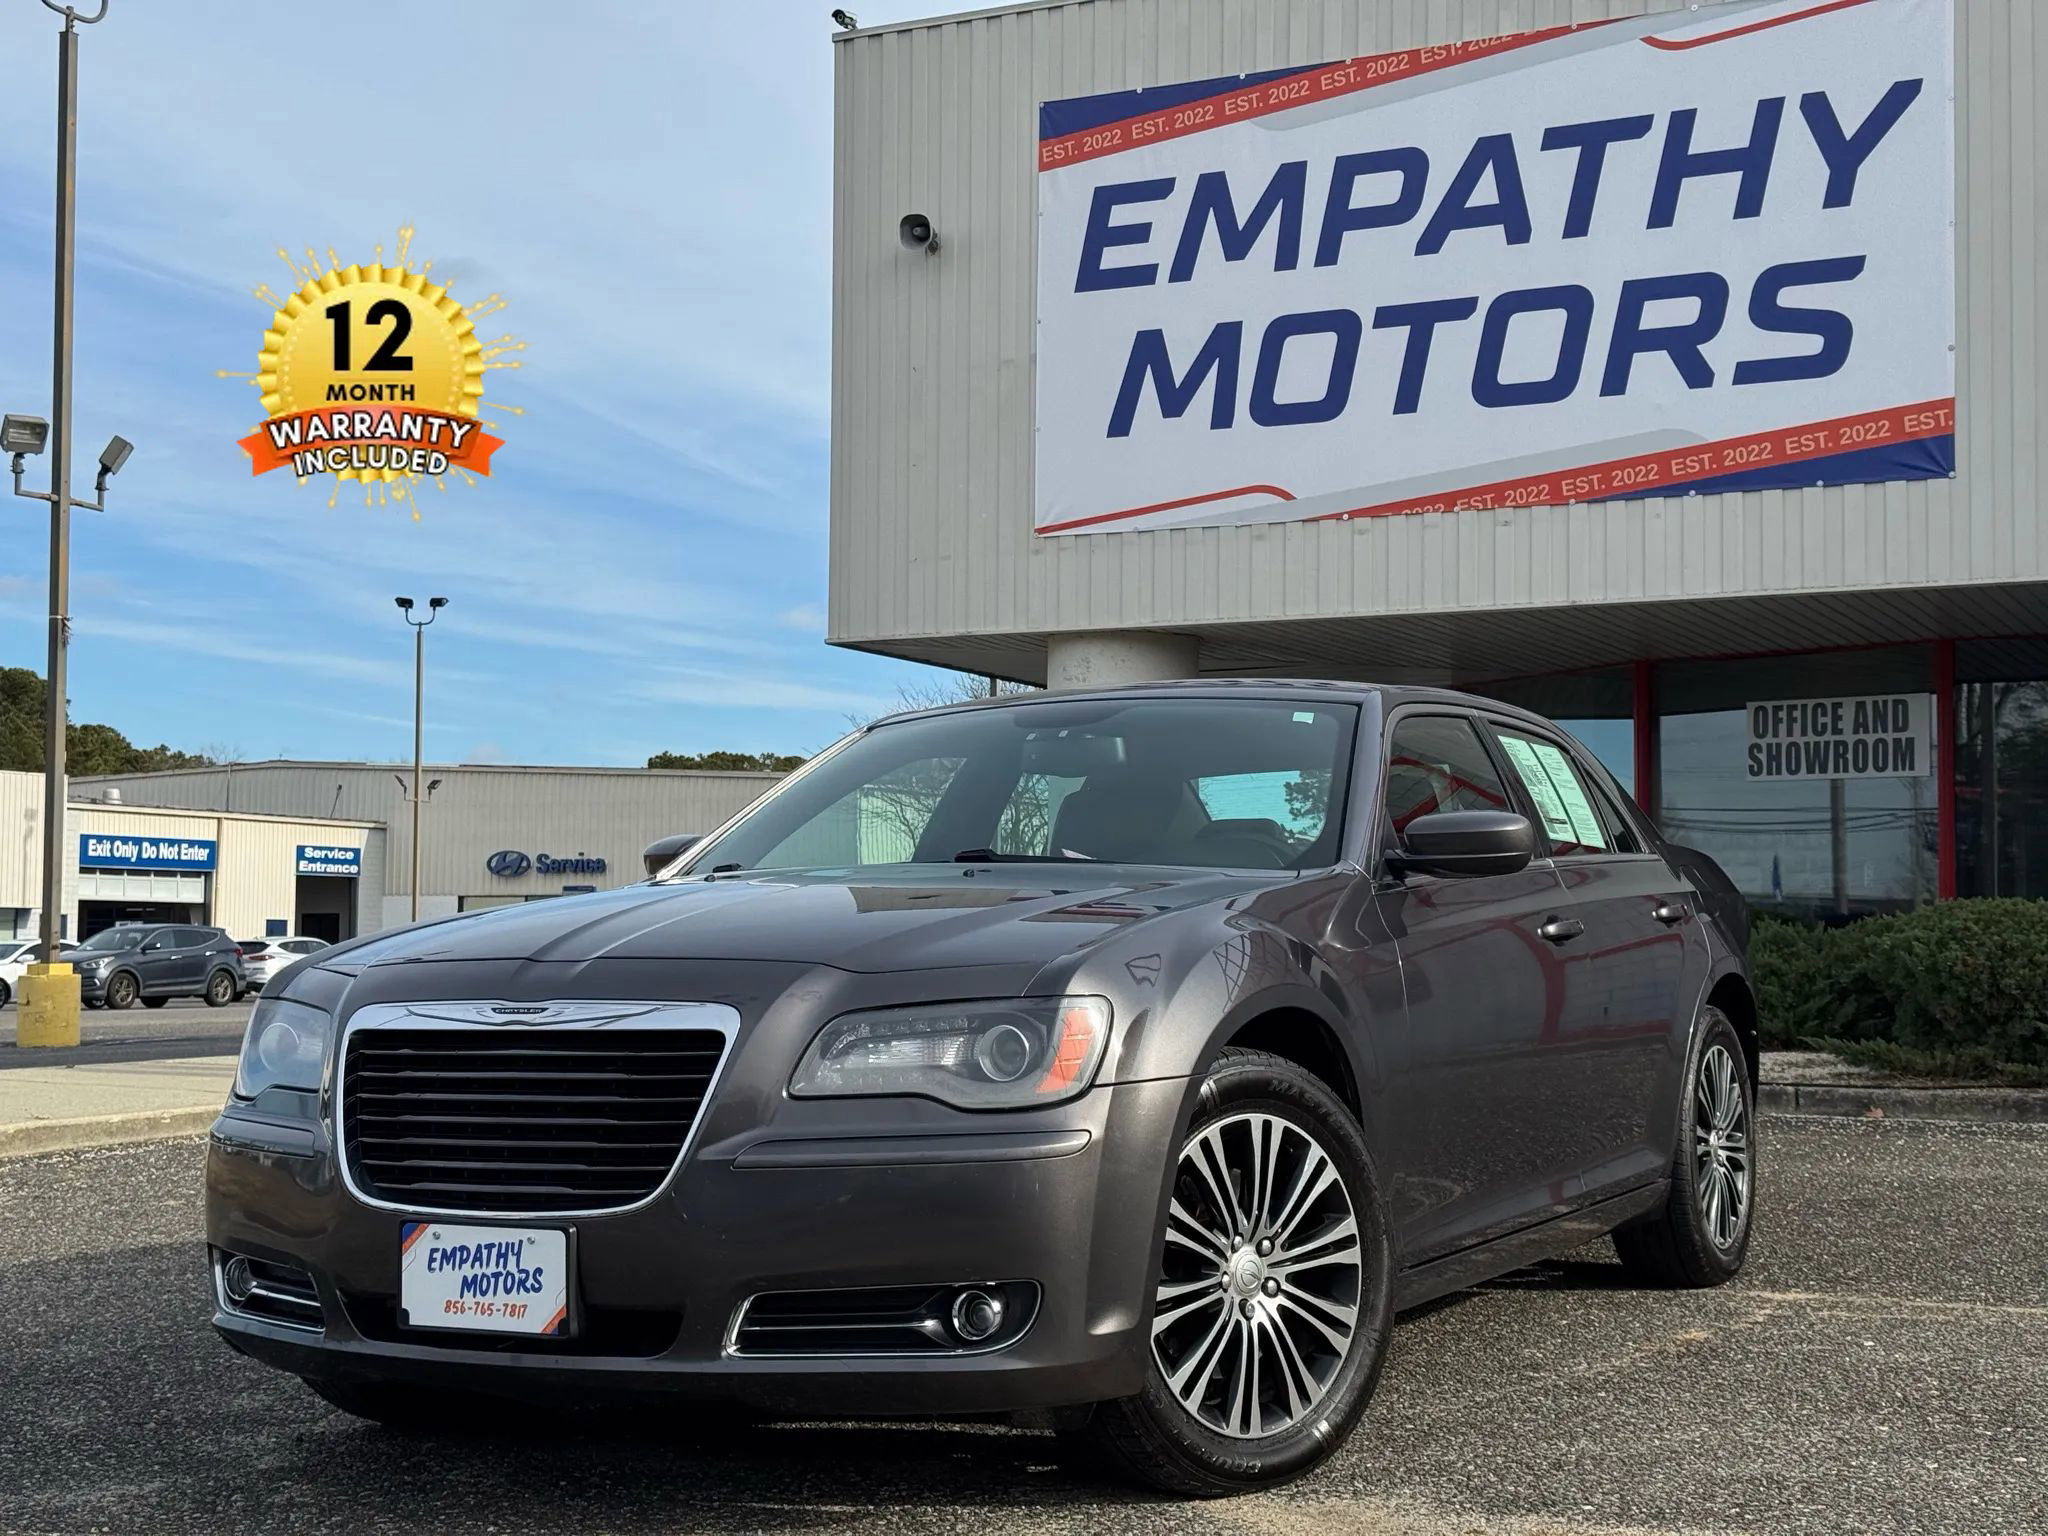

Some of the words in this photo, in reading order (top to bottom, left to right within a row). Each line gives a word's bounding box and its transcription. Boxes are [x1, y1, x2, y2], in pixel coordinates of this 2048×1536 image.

[1042, 141, 1078, 163] EST.
[1083, 129, 1122, 152] 2022
[1131, 117, 1169, 140] EST.
[1174, 105, 1215, 129] 2022
[1224, 93, 1263, 115] EST.
[1268, 80, 1310, 105] 2022
[1320, 67, 1361, 91] EST.
[1366, 53, 1410, 78] 2022
[1074, 78, 1924, 293] EMPATHY
[1106, 255, 1868, 438] MOTORS
[1504, 484, 1550, 507] 2022
[1562, 474, 1605, 496] EST.
[1612, 463, 1659, 487] 2022
[1671, 453, 1717, 476] EST.
[1723, 443, 1773, 466] 2022
[1785, 431, 1832, 454] EST.
[1839, 420, 1891, 445] 2022
[1904, 409, 1953, 433] EST.
[1752, 702, 1844, 739] OFFICE
[1852, 699, 1909, 735] AND
[1748, 737, 1915, 777] SHOWROOM
[88, 838, 111, 857] Exit
[113, 840, 139, 862] Only
[142, 842, 157, 860] Do
[159, 842, 178, 861] Not
[181, 843, 209, 862] Enter
[304, 847, 354, 860] Service
[536, 852, 606, 874] Service
[299, 861, 358, 874] Entrance
[427, 1239, 523, 1273] EMPATHY
[460, 1267, 543, 1300] MOTORS
[444, 1300, 528, 1319] 856-765-7817
